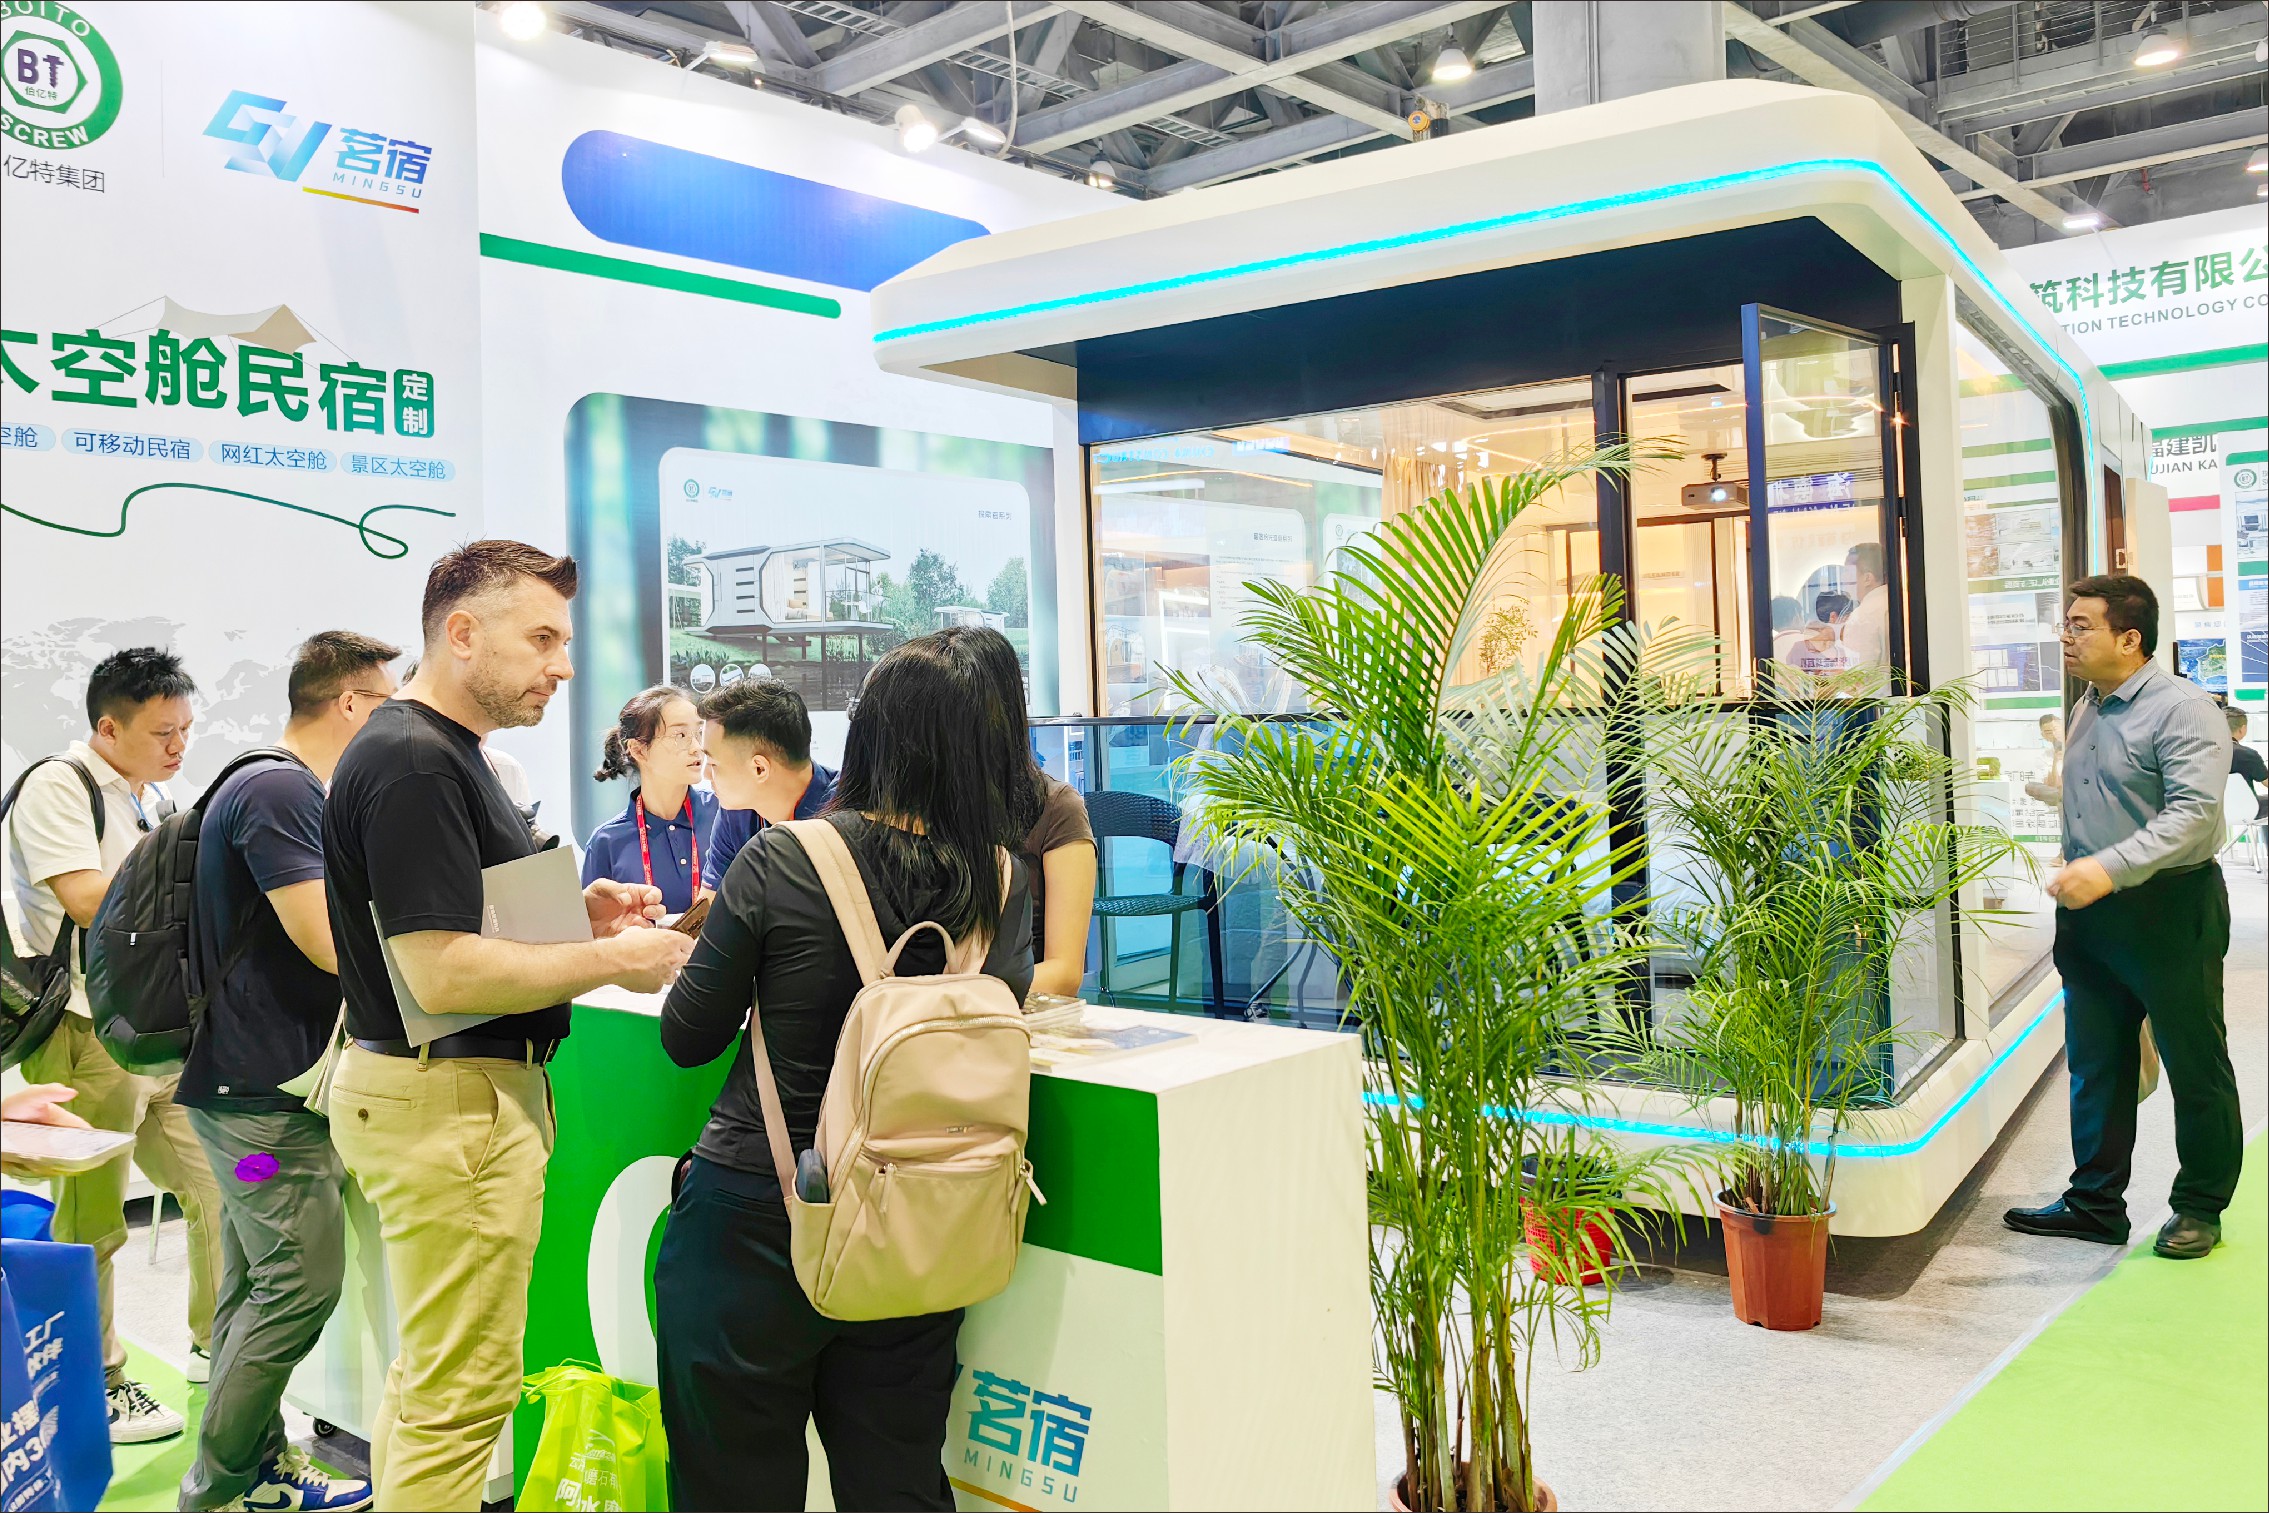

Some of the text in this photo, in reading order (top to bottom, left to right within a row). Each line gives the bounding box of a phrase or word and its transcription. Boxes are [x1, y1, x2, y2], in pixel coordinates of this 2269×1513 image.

[18, 48, 64, 88] BT
[25, 86, 58, 101] 伯亿特
[1, 113, 89, 147] SCREW
[4, 154, 104, 193] 亿特集团
[336, 127, 433, 185] 茗宿
[332, 172, 423, 199] MINGSU
[2107, 299, 2238, 329] TECHNOLOGY
[401, 373, 429, 435] 定制
[74, 431, 191, 460] 可移动民宿
[221, 443, 327, 471] 网红太空舱
[351, 455, 446, 480] 景区太空舱
[2198, 458, 2218, 470] KA
[966, 1369, 1092, 1477] 茗宿
[964, 1447, 1078, 1503] MINGSU
